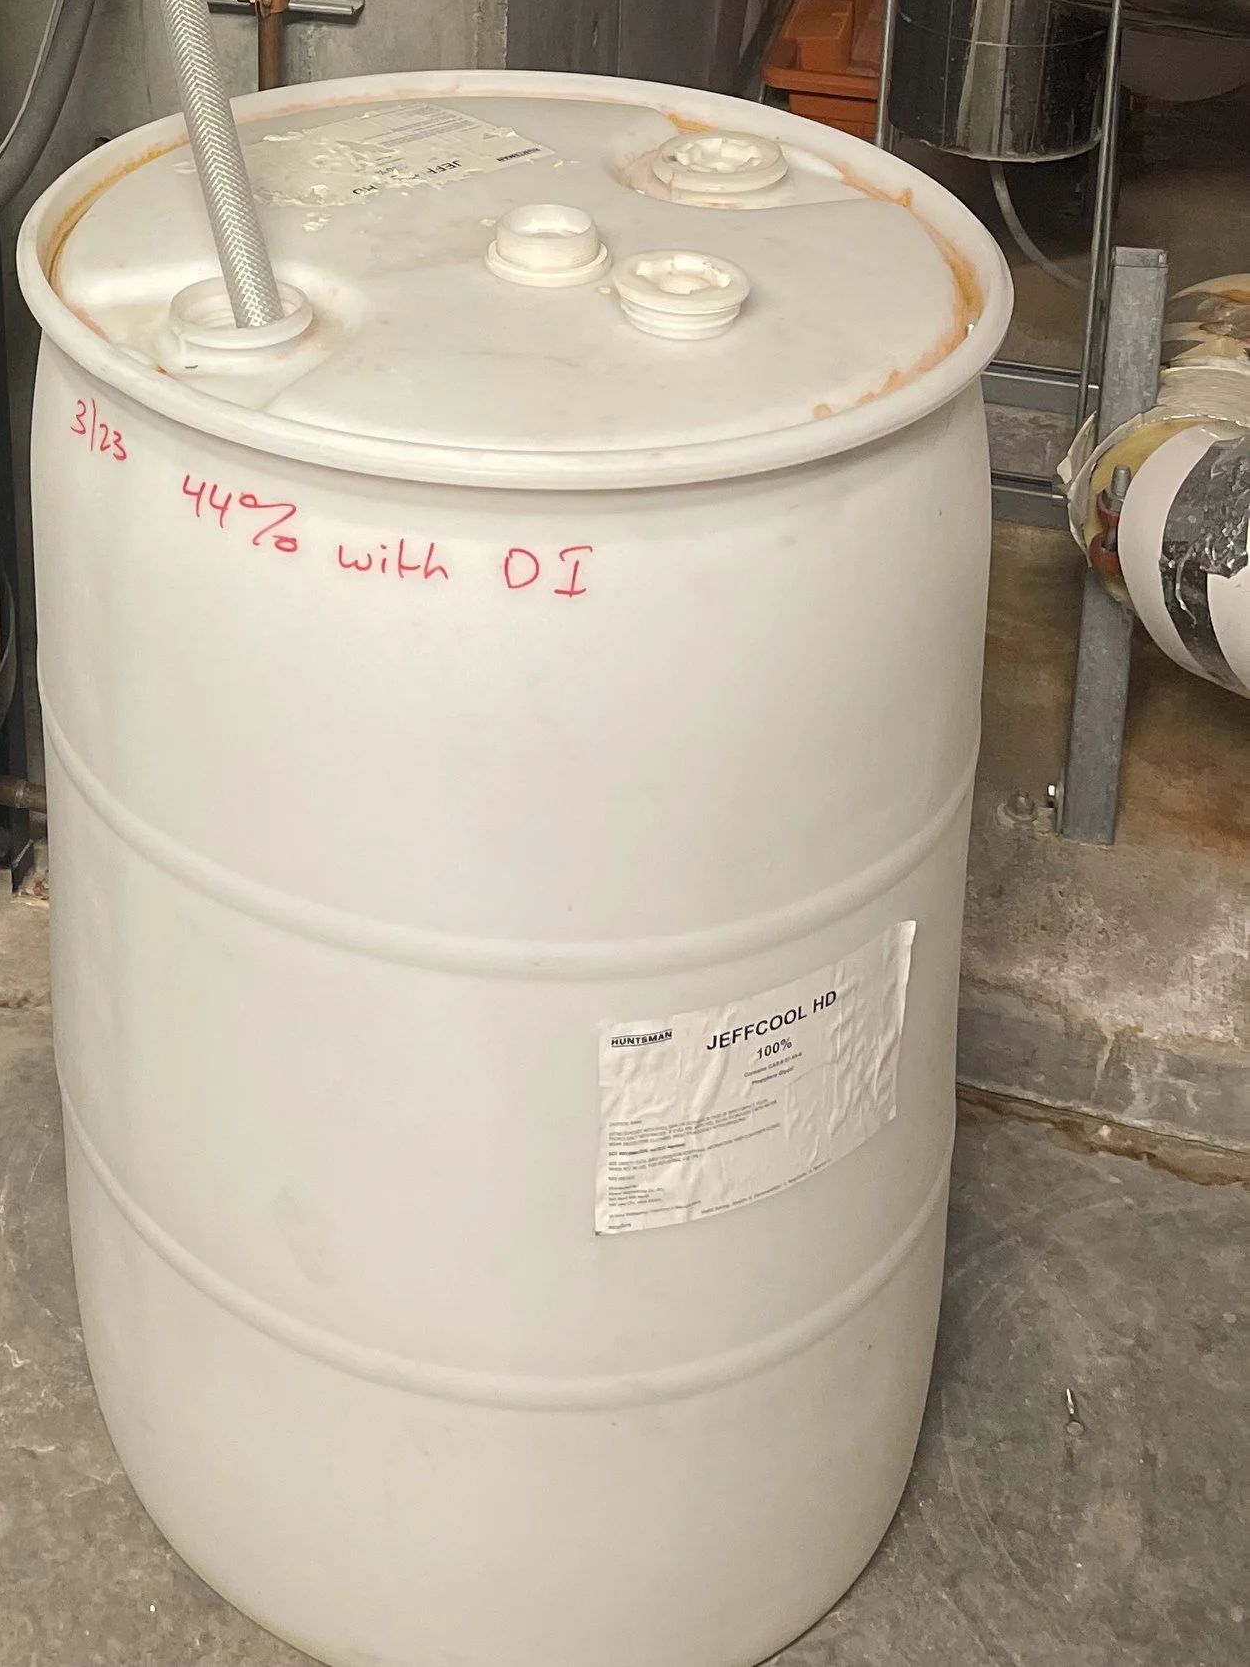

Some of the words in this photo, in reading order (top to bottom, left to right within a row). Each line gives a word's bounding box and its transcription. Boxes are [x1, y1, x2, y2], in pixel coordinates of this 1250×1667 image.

[70, 399, 127, 461] 3/23
[182, 474, 299, 553] 44%
[337, 538, 449, 580] with
[611, 1030, 673, 1046] HUNTSMAN
[707, 1005, 807, 1050] JEFFCOOL
[813, 990, 837, 1013] HD
[757, 1036, 793, 1060] 100%
